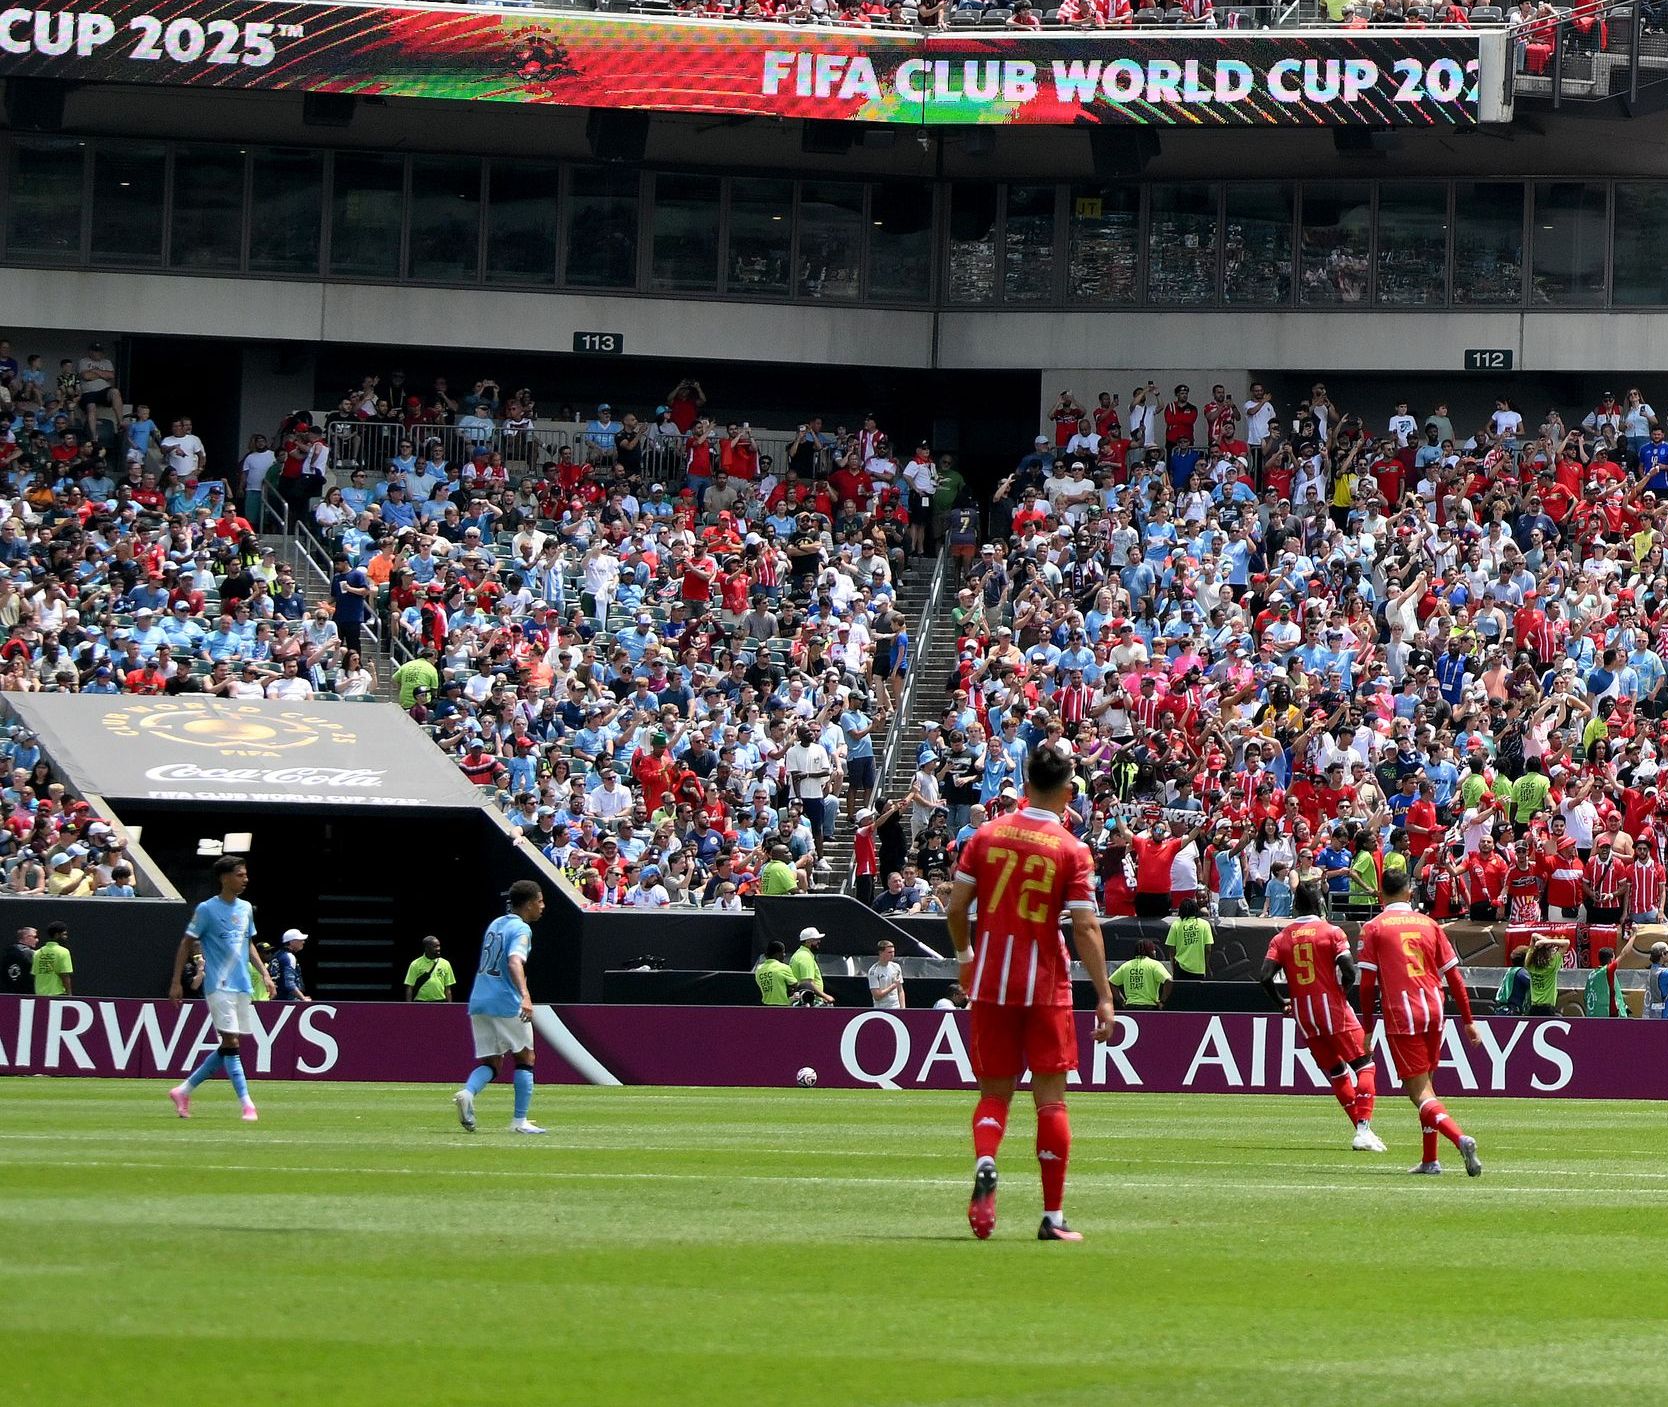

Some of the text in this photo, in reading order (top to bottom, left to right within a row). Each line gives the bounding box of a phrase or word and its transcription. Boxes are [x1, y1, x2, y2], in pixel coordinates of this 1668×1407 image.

[761, 49, 878, 103] FIFA
[895, 57, 1038, 105] CLUB
[1051, 57, 1256, 105] WORLD
[1265, 58, 1380, 105] CUP
[582, 334, 615, 351] 113
[1472, 352, 1504, 367] 112
[986, 846, 1057, 923] 72
[1293, 942, 1316, 985] 9
[1399, 931, 1427, 978] 5
[0, 999, 339, 1075] IRWYS
[840, 1010, 1145, 1090] QAR
